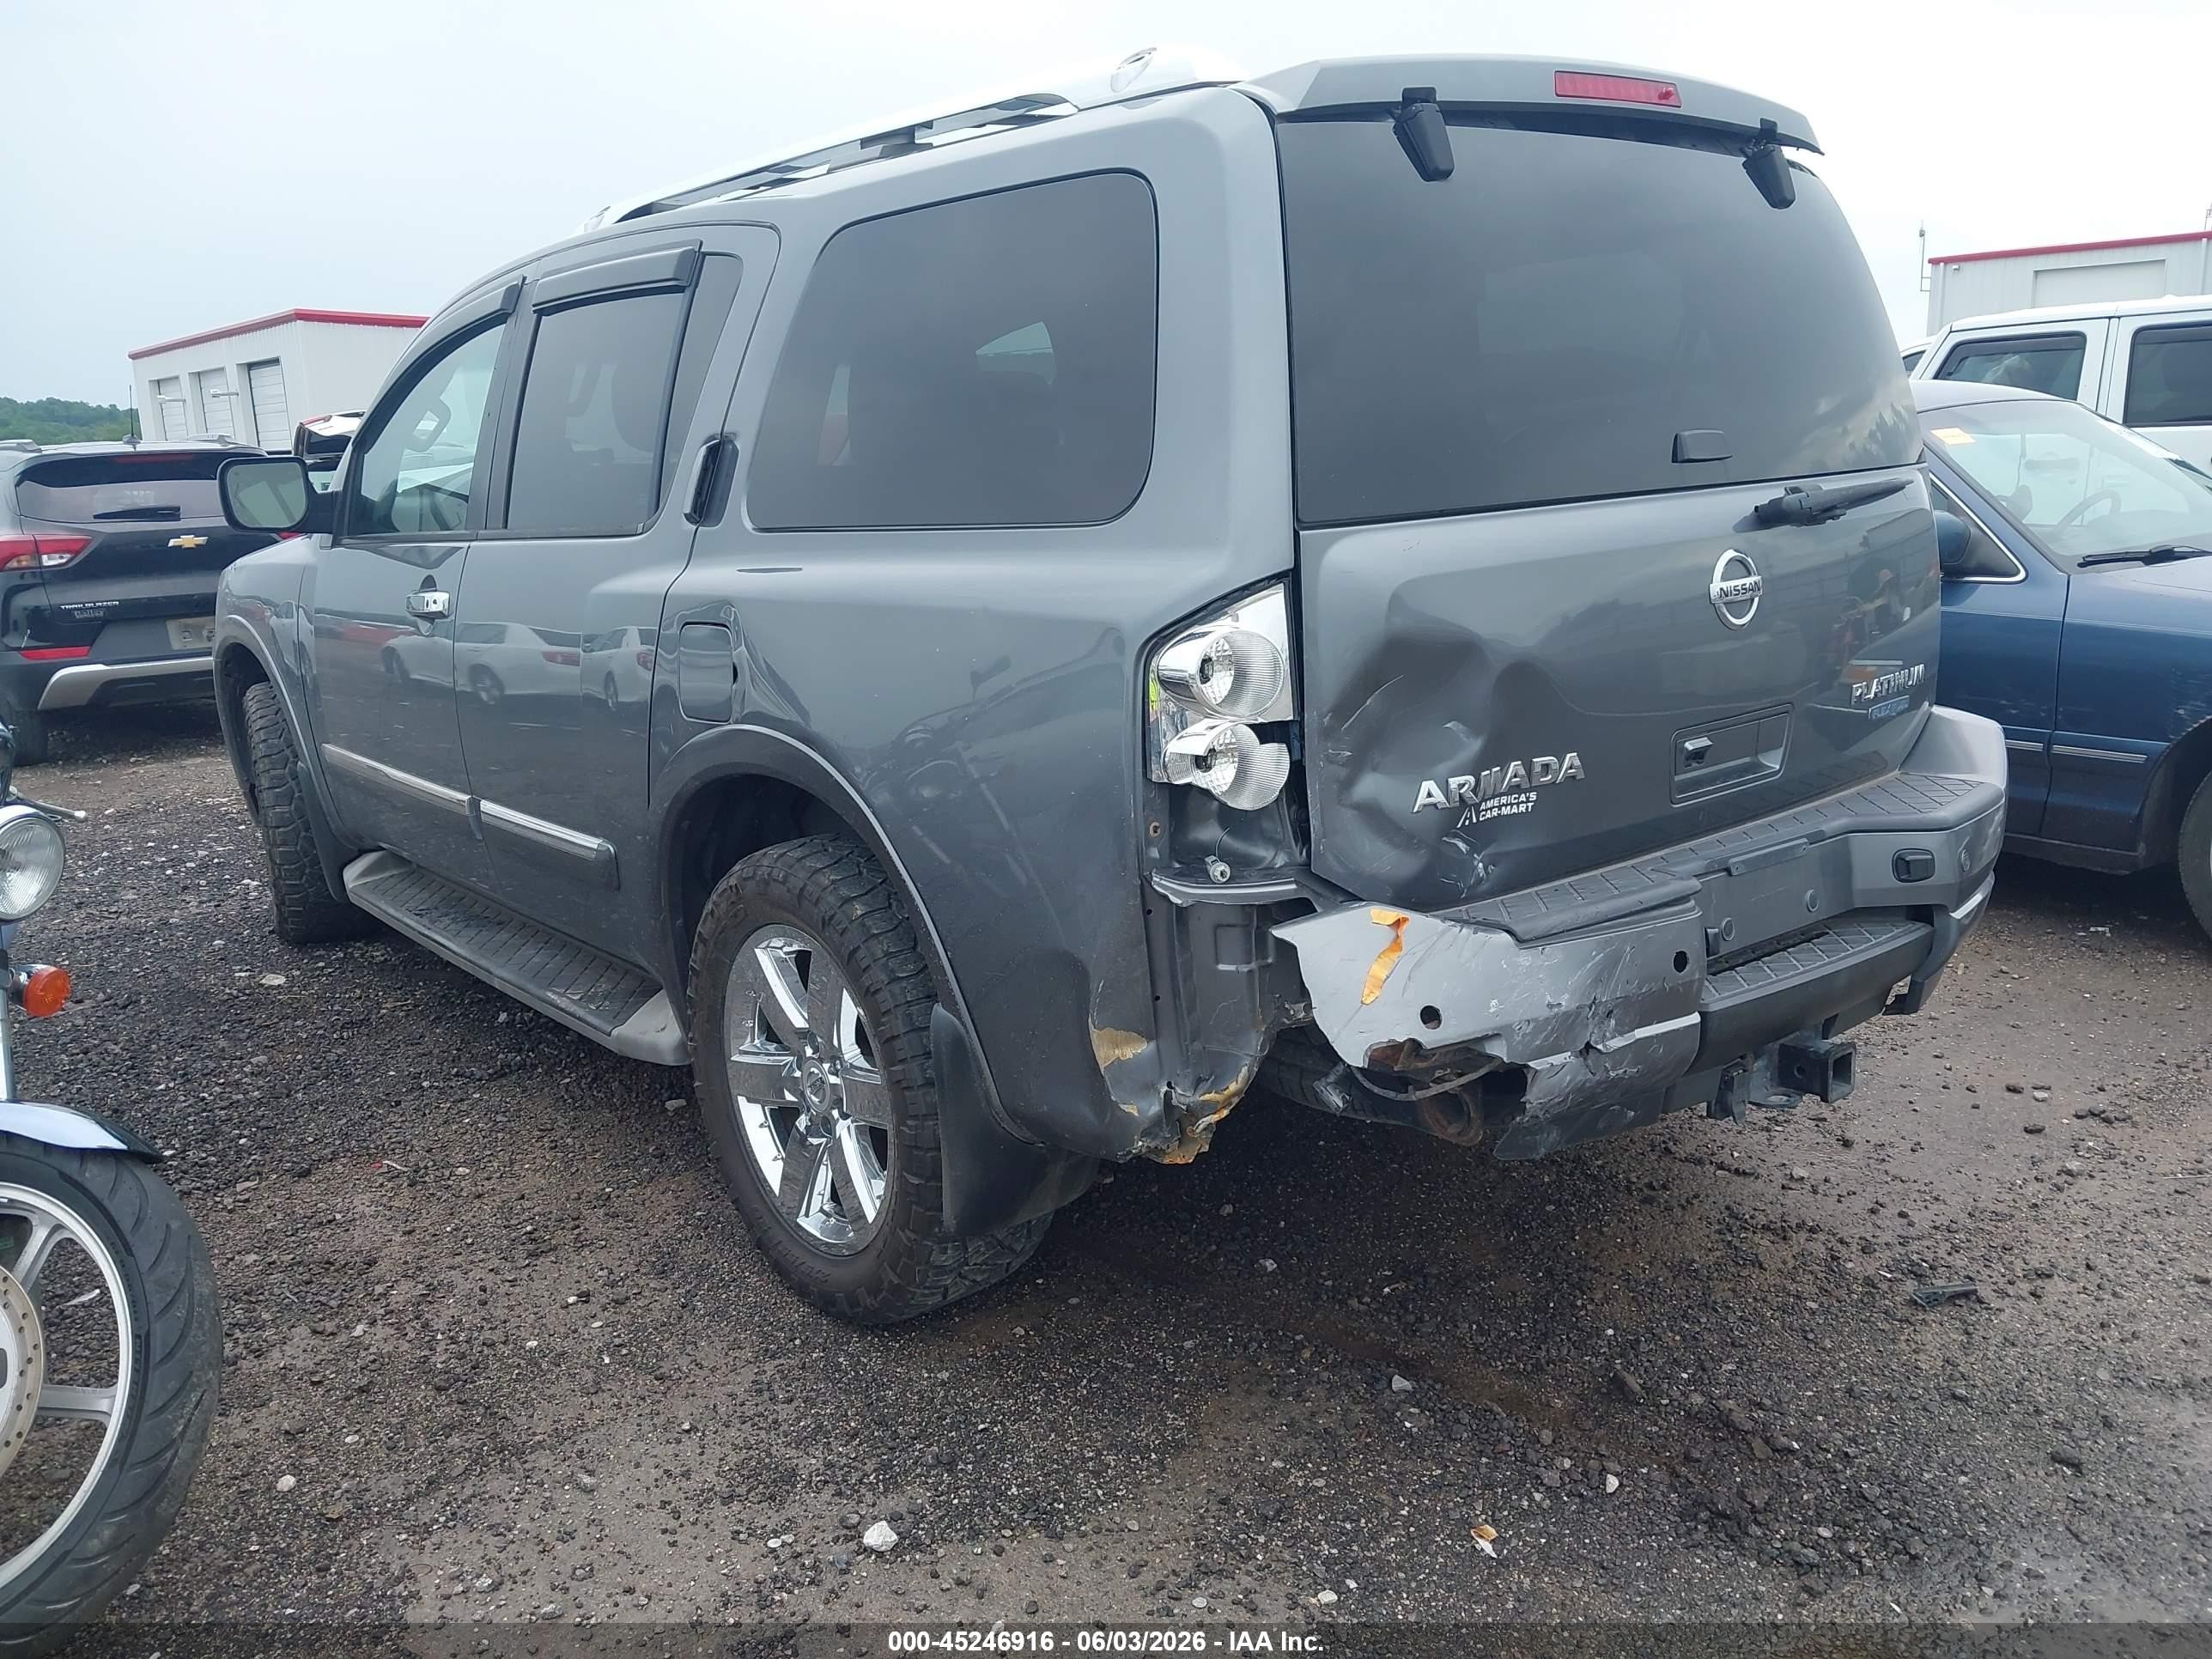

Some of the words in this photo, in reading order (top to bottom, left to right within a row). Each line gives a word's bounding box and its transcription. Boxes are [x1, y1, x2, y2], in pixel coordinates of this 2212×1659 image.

[1717, 580, 1761, 599] NISSAN
[1850, 664, 1925, 705] PLATINUM
[1412, 752, 1586, 813] ARMADA
[1480, 792, 1537, 811] AMERICA'S
[1479, 802, 1534, 821] CAR-MART
